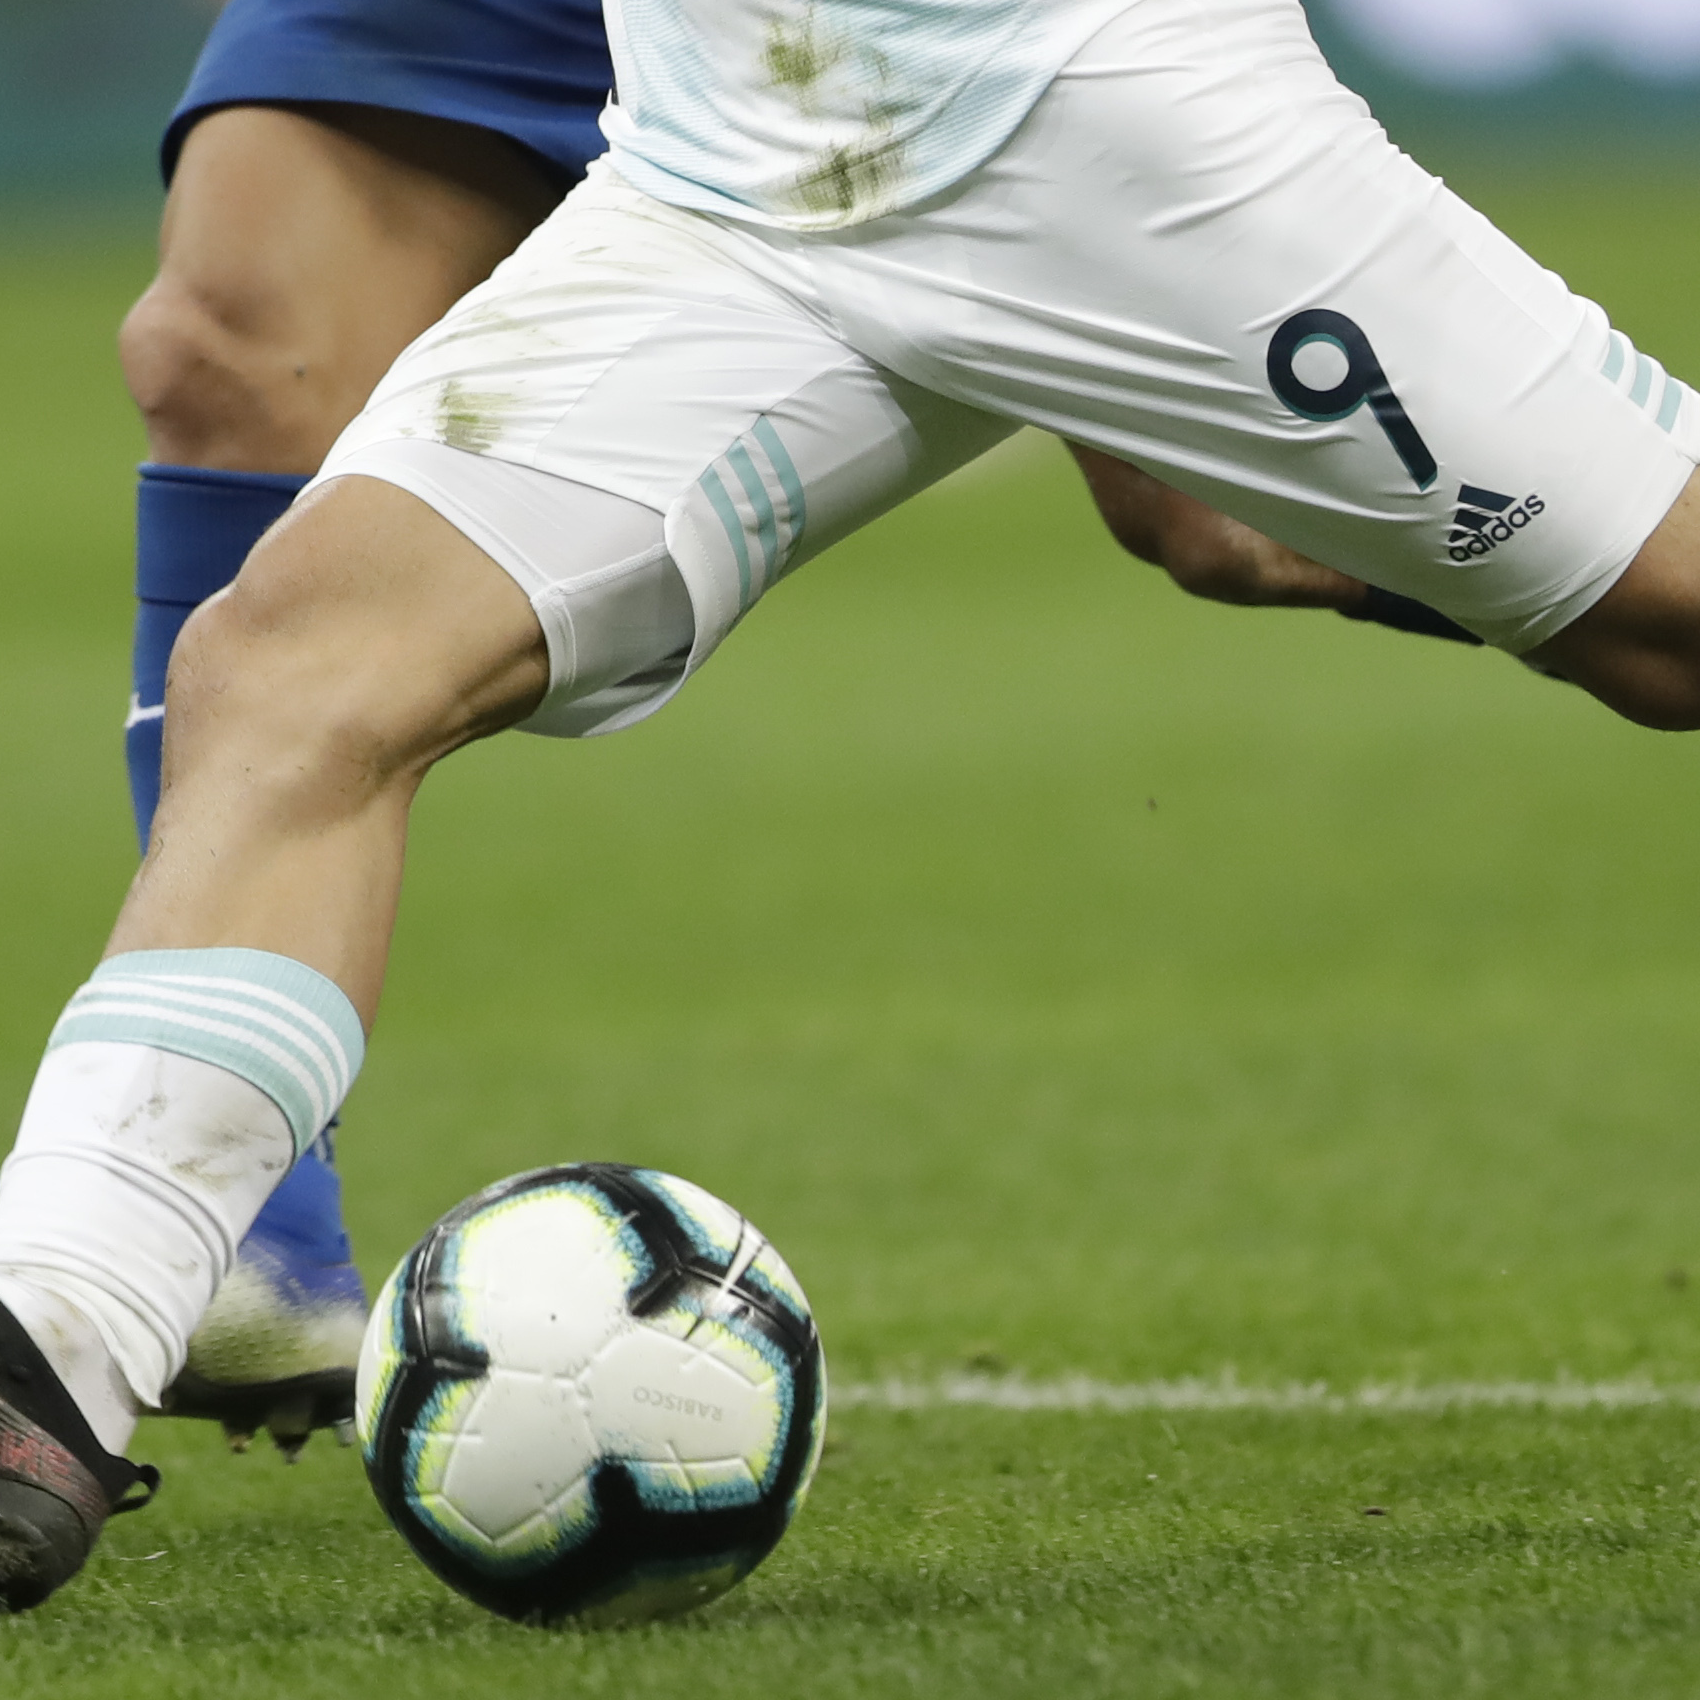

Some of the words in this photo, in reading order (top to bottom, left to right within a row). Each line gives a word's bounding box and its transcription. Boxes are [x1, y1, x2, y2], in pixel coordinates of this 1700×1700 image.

[1266, 308, 1438, 493] 9
[1448, 494, 1546, 562] adidas
[632, 1386, 722, 1422] RABISCO
